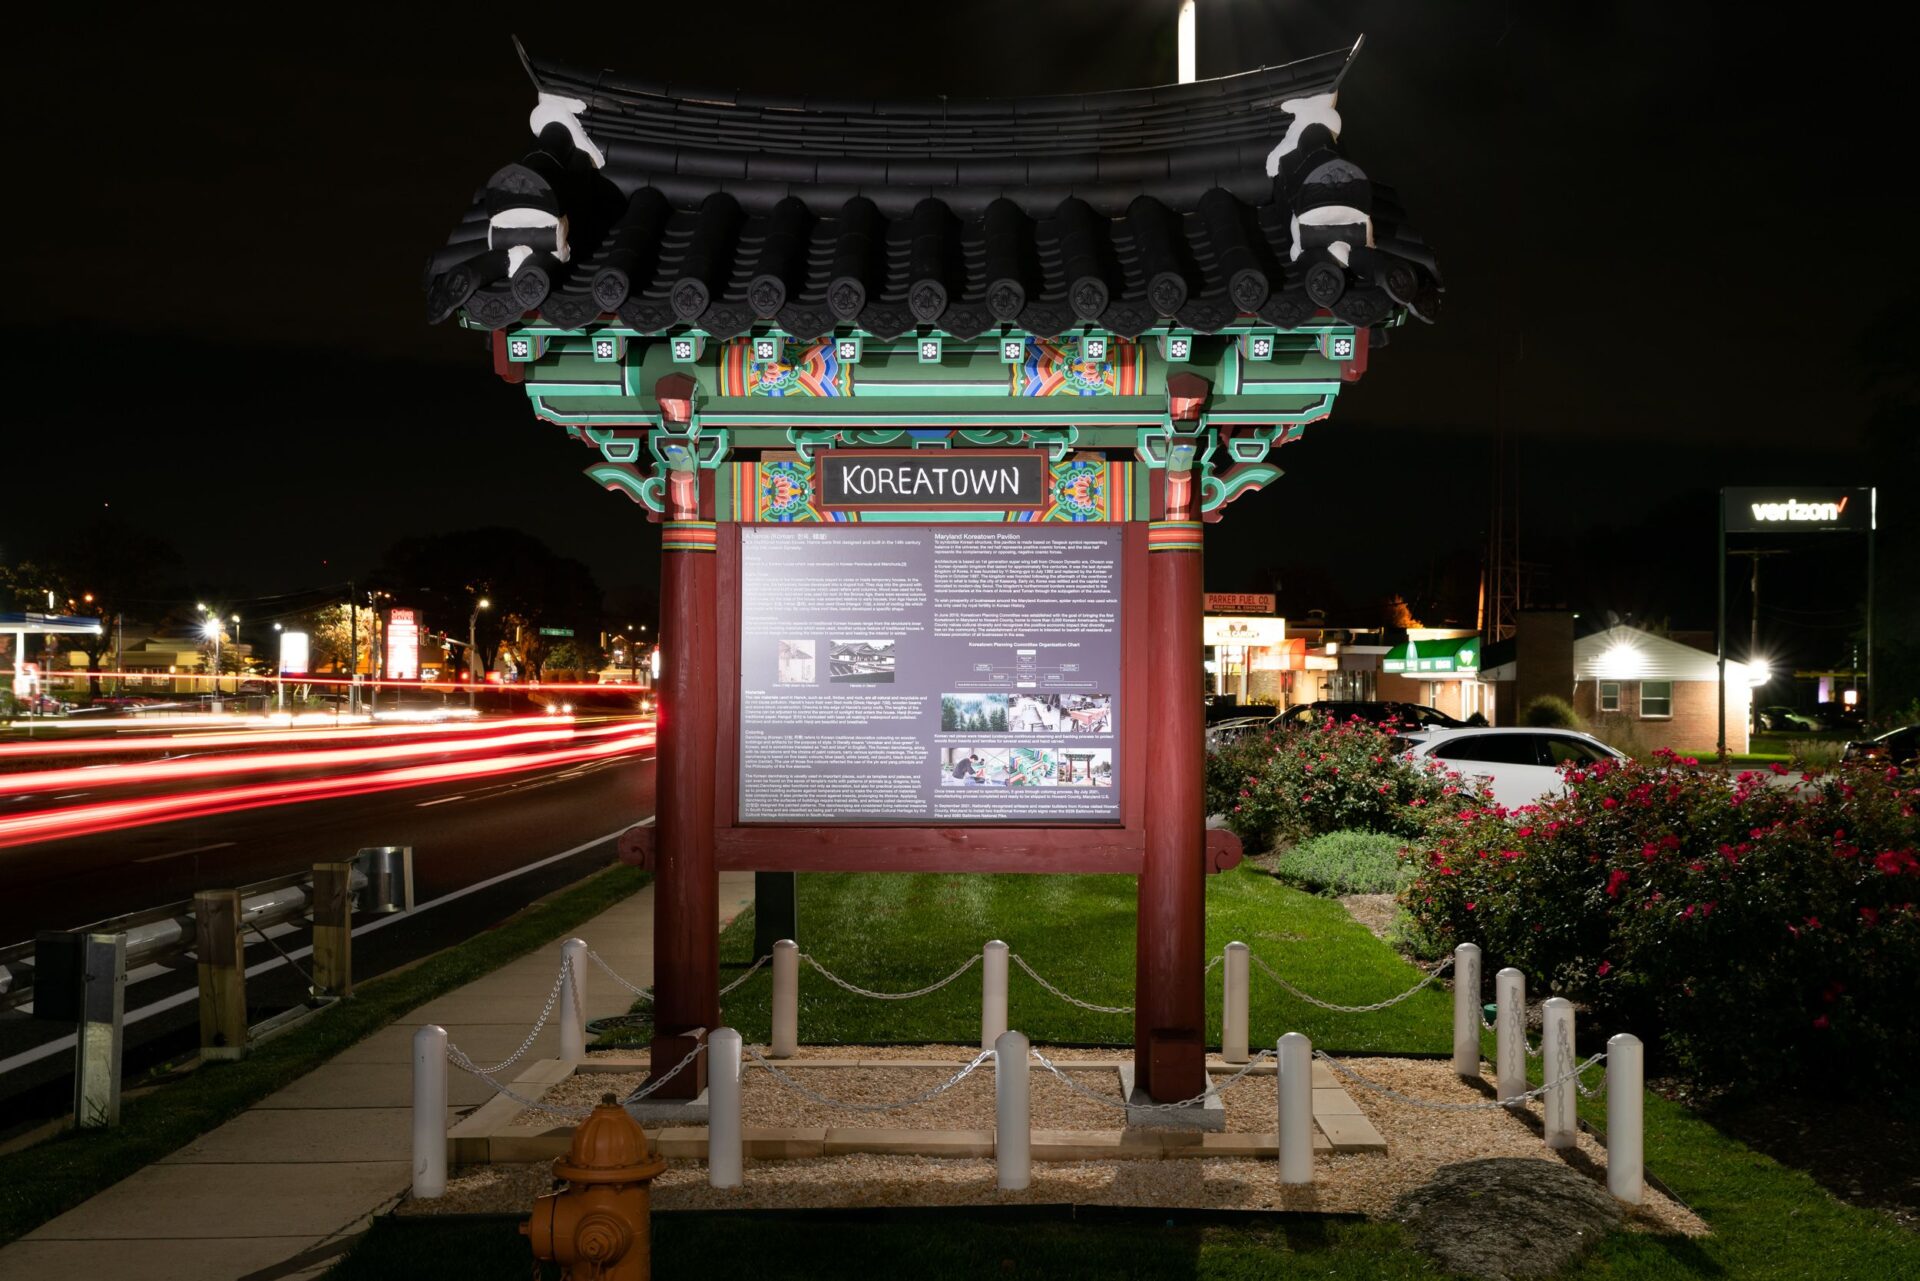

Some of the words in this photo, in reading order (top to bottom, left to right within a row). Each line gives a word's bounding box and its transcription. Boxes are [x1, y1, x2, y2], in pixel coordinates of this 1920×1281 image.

[843, 465, 1020, 496] KOREATOWN
[1751, 498, 1838, 522] verizon
[1209, 595, 1236, 604] PARKER
[1239, 595, 1255, 604] FUEL
[1259, 596, 1270, 605] CO.
